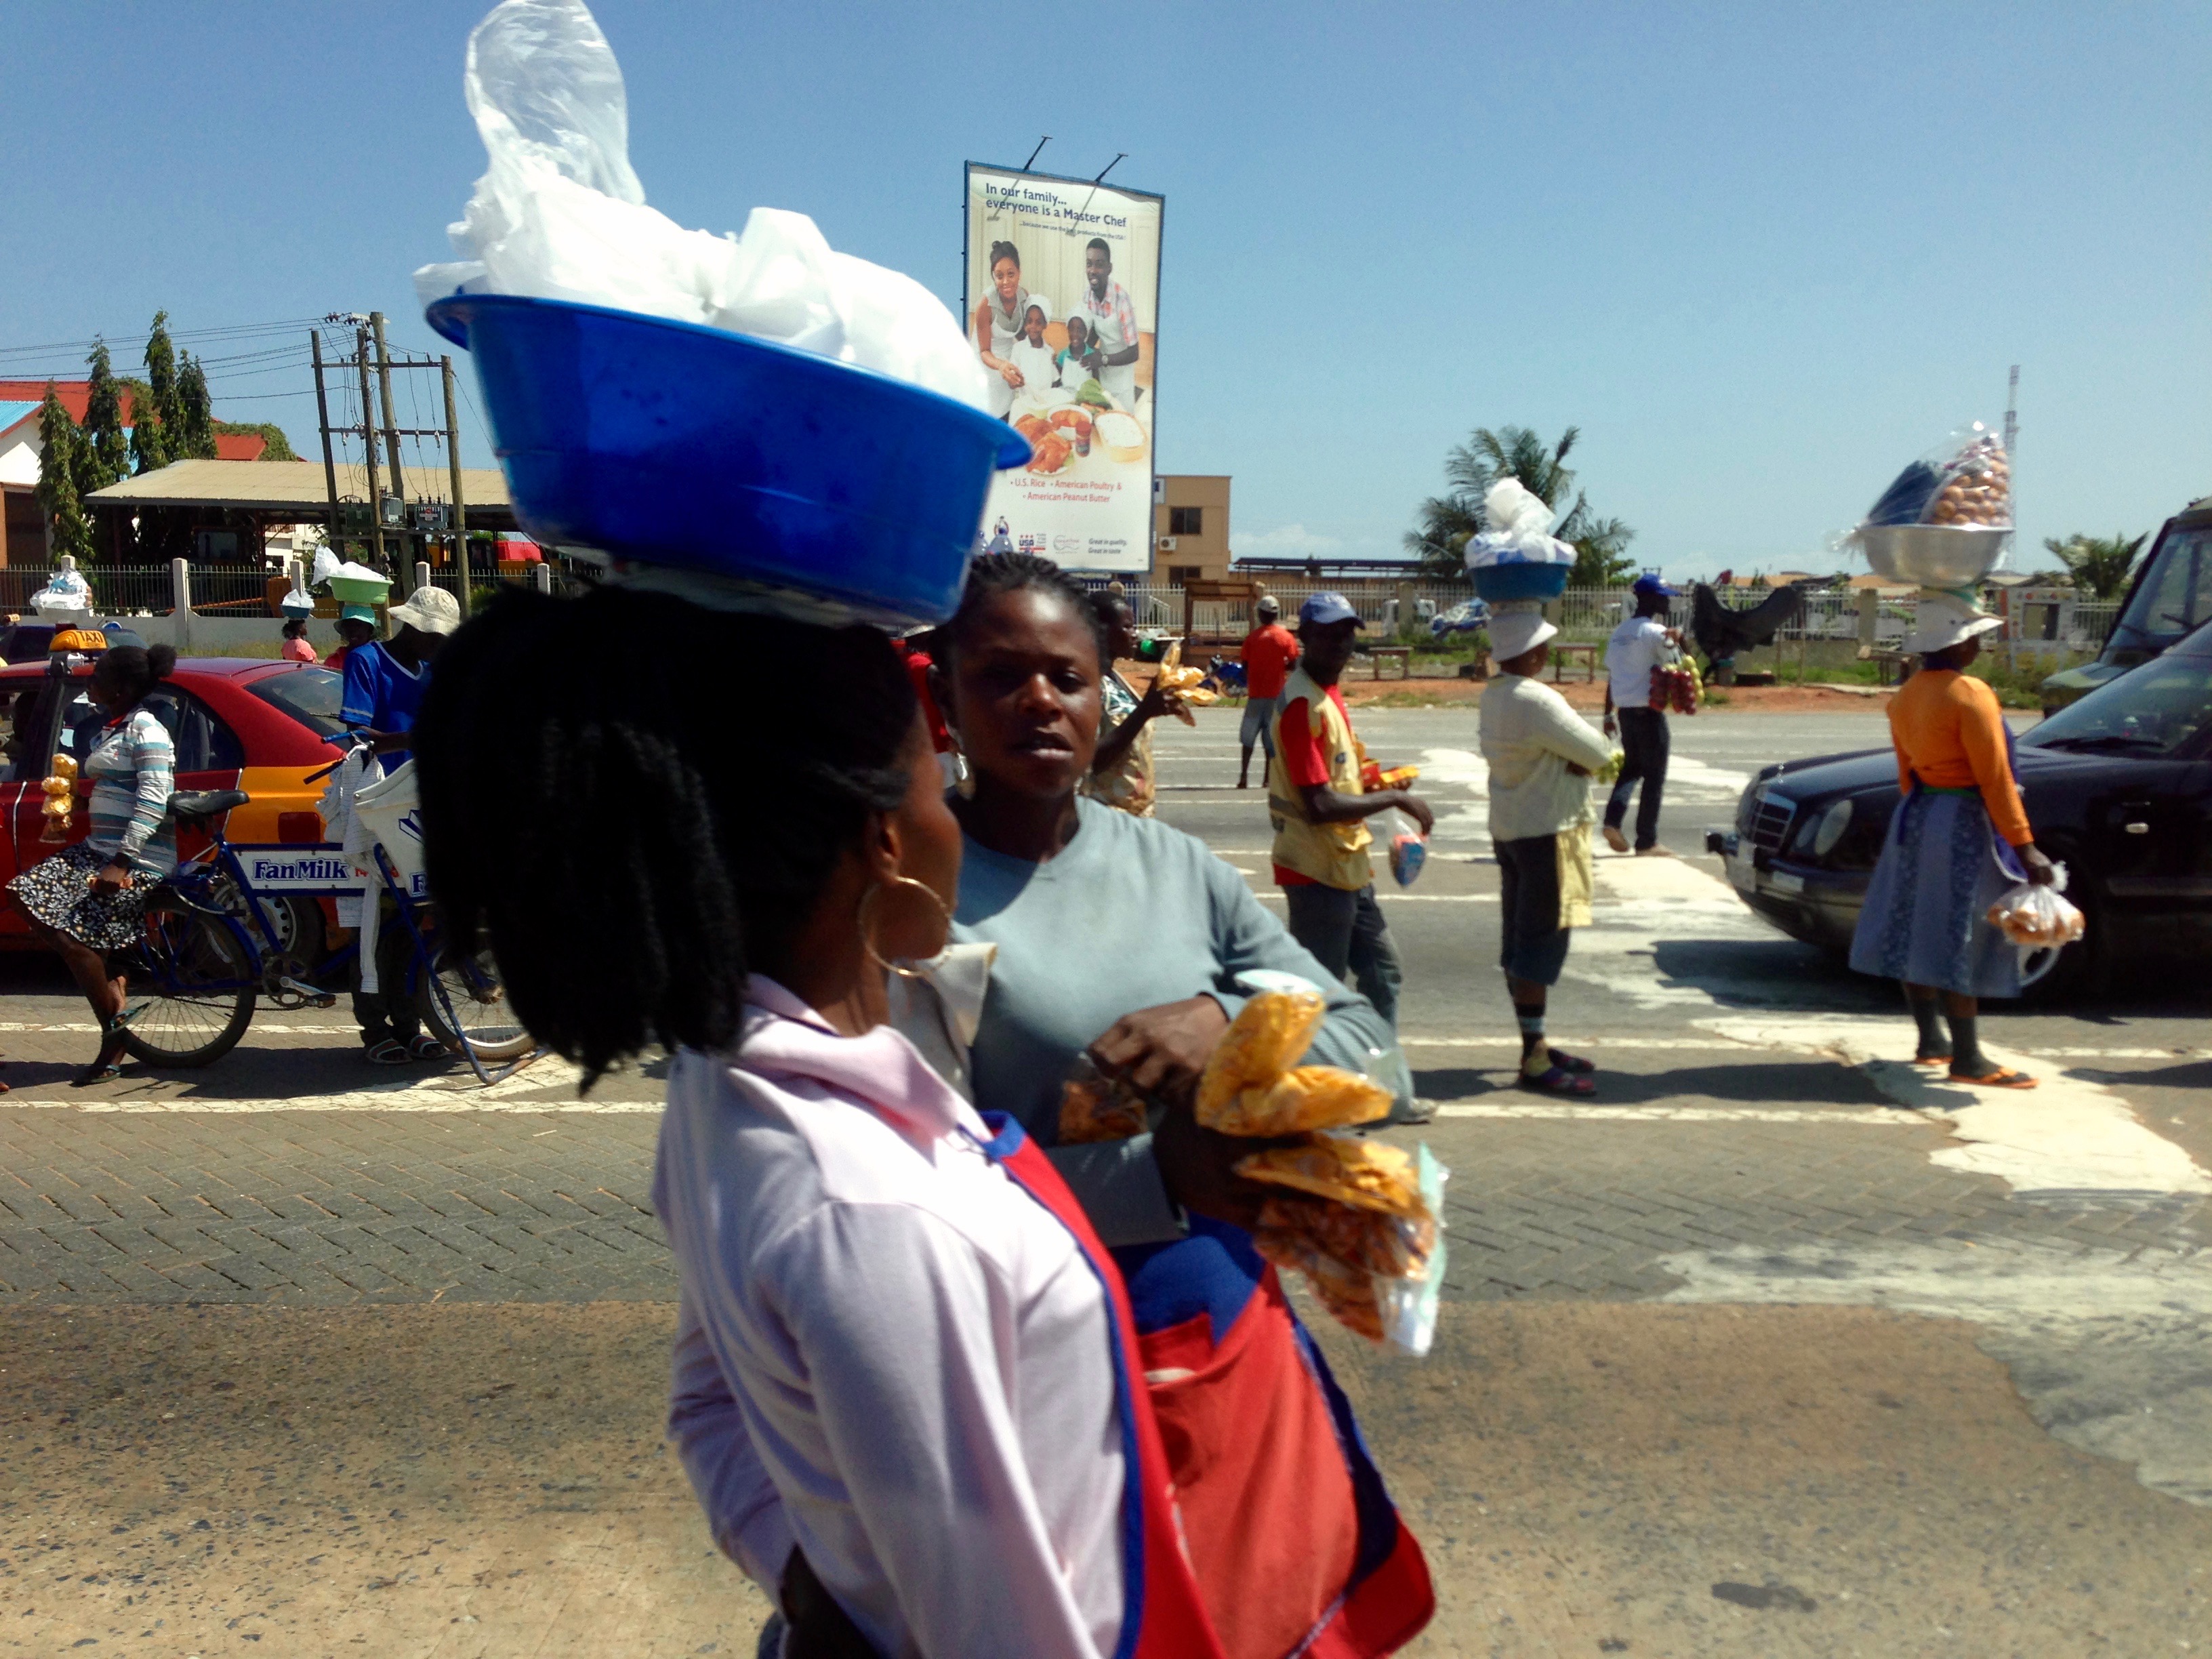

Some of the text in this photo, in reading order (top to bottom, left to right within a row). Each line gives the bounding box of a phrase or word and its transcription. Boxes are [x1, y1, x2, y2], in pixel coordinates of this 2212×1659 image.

[986, 182, 1067, 206] In our family...
[986, 199, 1127, 227] everyone is a Master Chef
[1015, 478, 1028, 487] U.S.
[1030, 478, 1046, 487] Rice
[1054, 479, 1089, 489] American
[1090, 480, 1114, 491] Poultry
[1027, 491, 1110, 502] American Peanut Butter
[76, 630, 104, 643] TAXI
[253, 858, 349, 880] FanMilk
